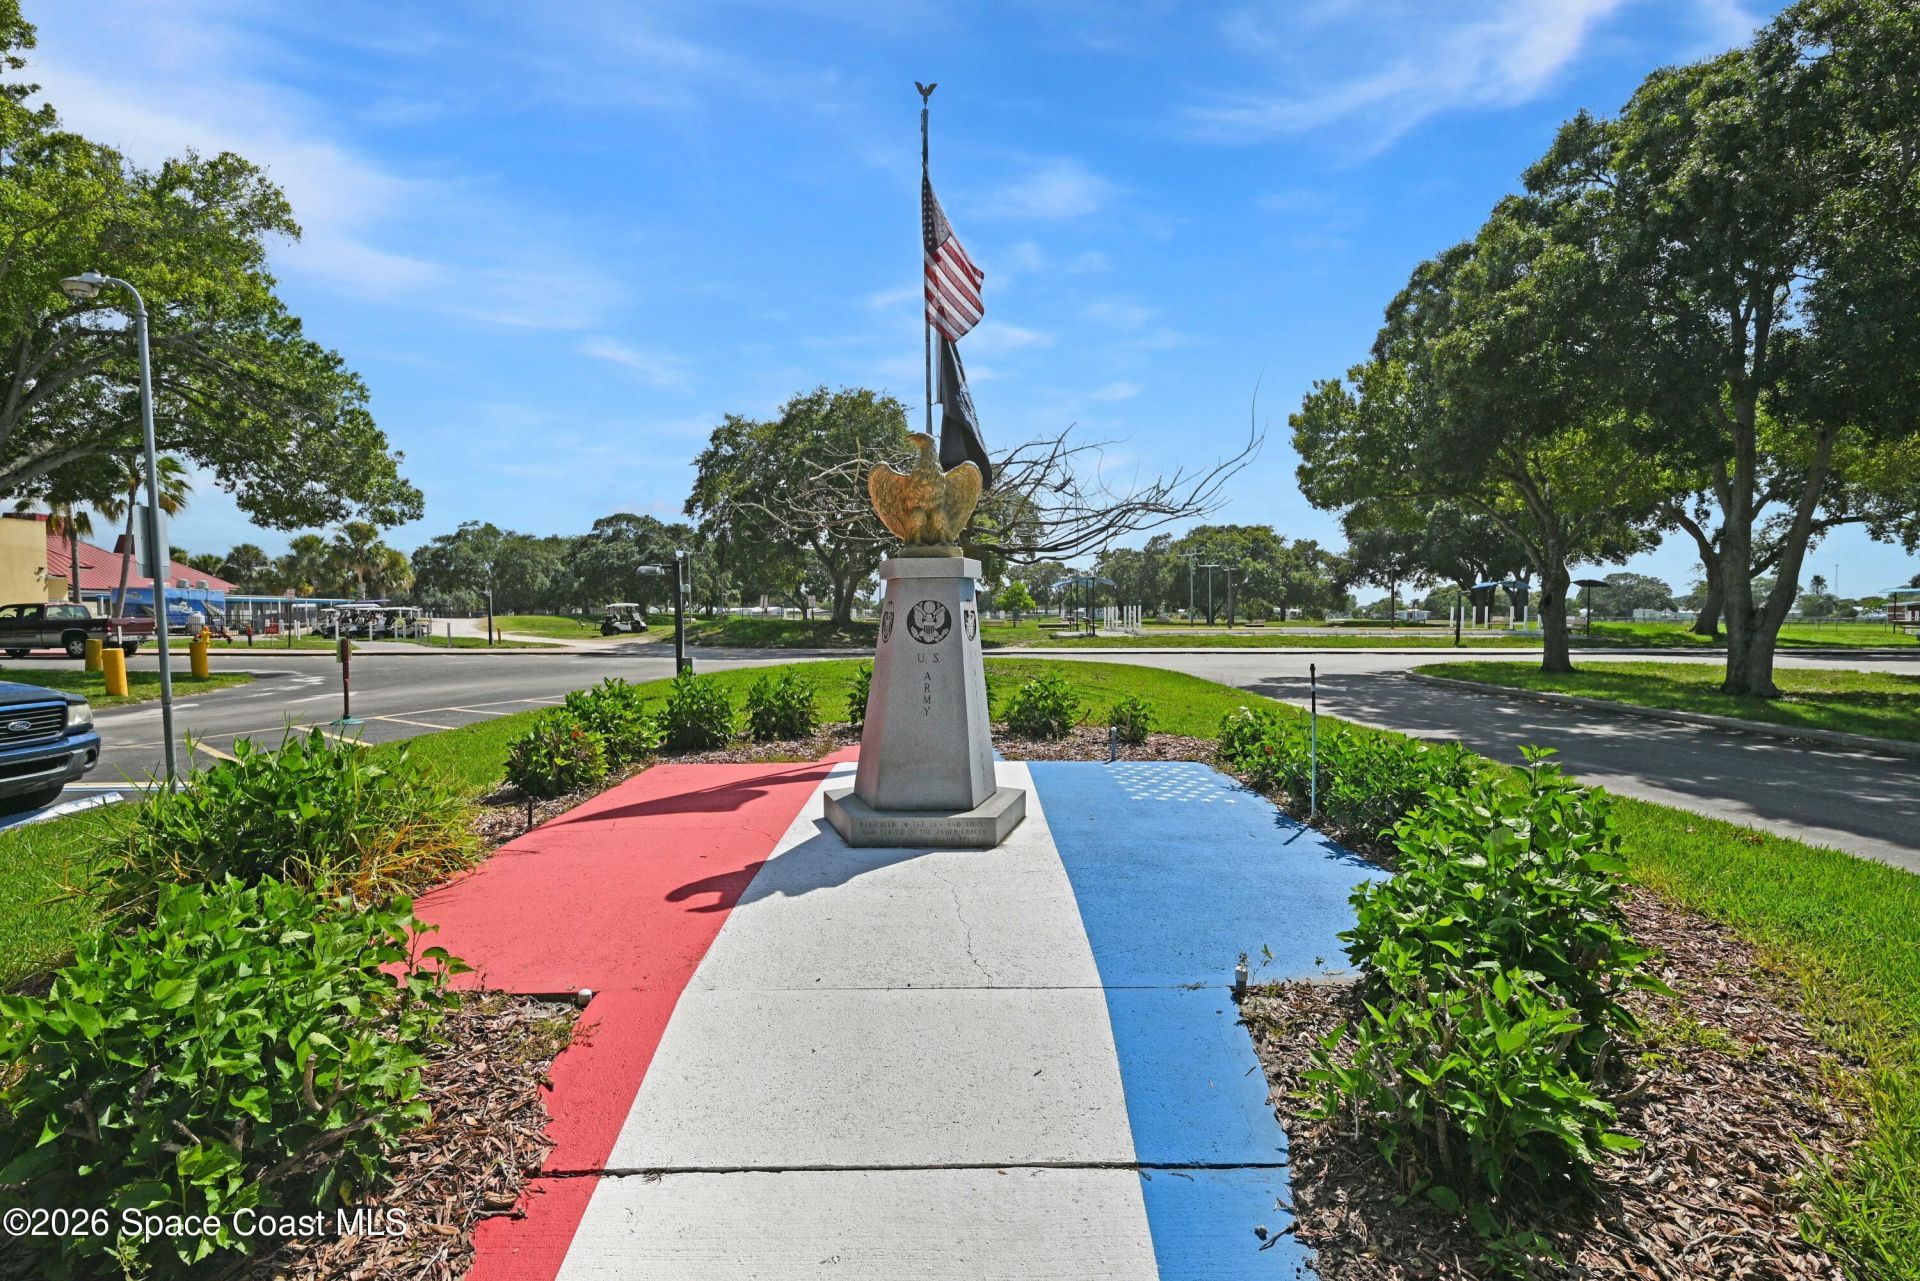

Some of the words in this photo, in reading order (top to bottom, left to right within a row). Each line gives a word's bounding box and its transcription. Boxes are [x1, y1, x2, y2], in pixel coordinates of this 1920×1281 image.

[917, 653, 927, 663] U.
[932, 653, 941, 663] S.
[922, 671, 931, 716] ARMY
